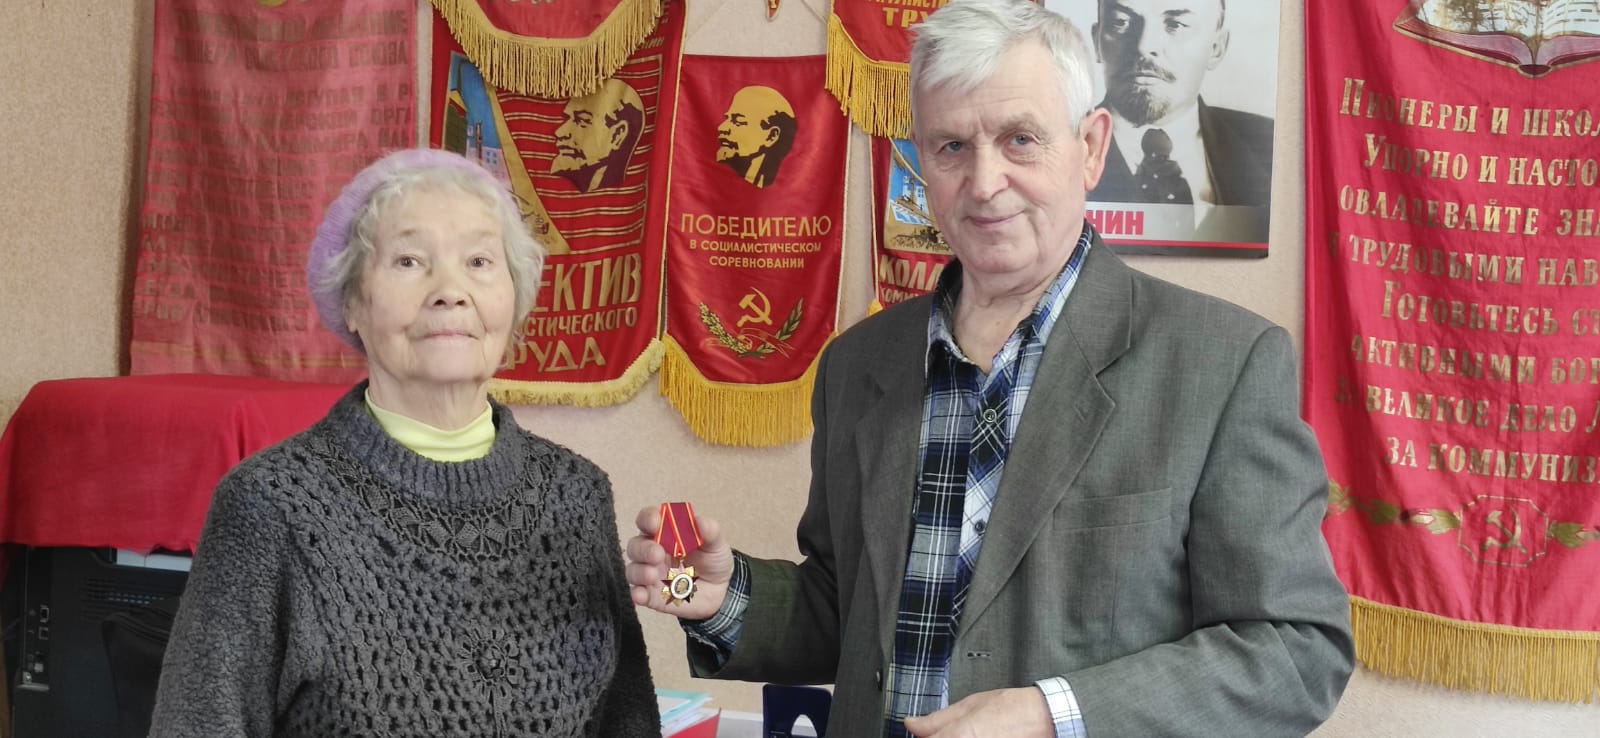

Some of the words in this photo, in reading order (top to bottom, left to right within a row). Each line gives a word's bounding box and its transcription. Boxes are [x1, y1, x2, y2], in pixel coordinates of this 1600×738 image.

[1340, 78, 1478, 132] ПИОНЕРЫ
[1490, 107, 1510, 135] И
[1364, 133, 1469, 181] УПОРНО
[1478, 155, 1498, 183] И
[1507, 157, 1598, 187] НАСТО
[681, 213, 832, 240] ПОБЕДИТЕЛЮ
[689, 239, 697, 250] В
[701, 240, 821, 254] СОЦИАЛИСТИЧЕСКОМ
[709, 255, 804, 269] СОРЕВНОВАНИИ
[1349, 234, 1525, 284] ТРУДОВЫМИ
[1538, 257, 1600, 286] НАВ
[524, 306, 638, 337] СТИЧЕСКОГО
[1381, 280, 1559, 336] ГОТОВЬТЕСЬ
[1351, 335, 1536, 383] АКТИВНЫМИ
[1366, 385, 1489, 428] ВЕЛИКОЕ
[1501, 403, 1577, 433] ДЕЛО
[1385, 436, 1417, 468] ЗА
[1428, 444, 1600, 483] КОММУНИЗ
